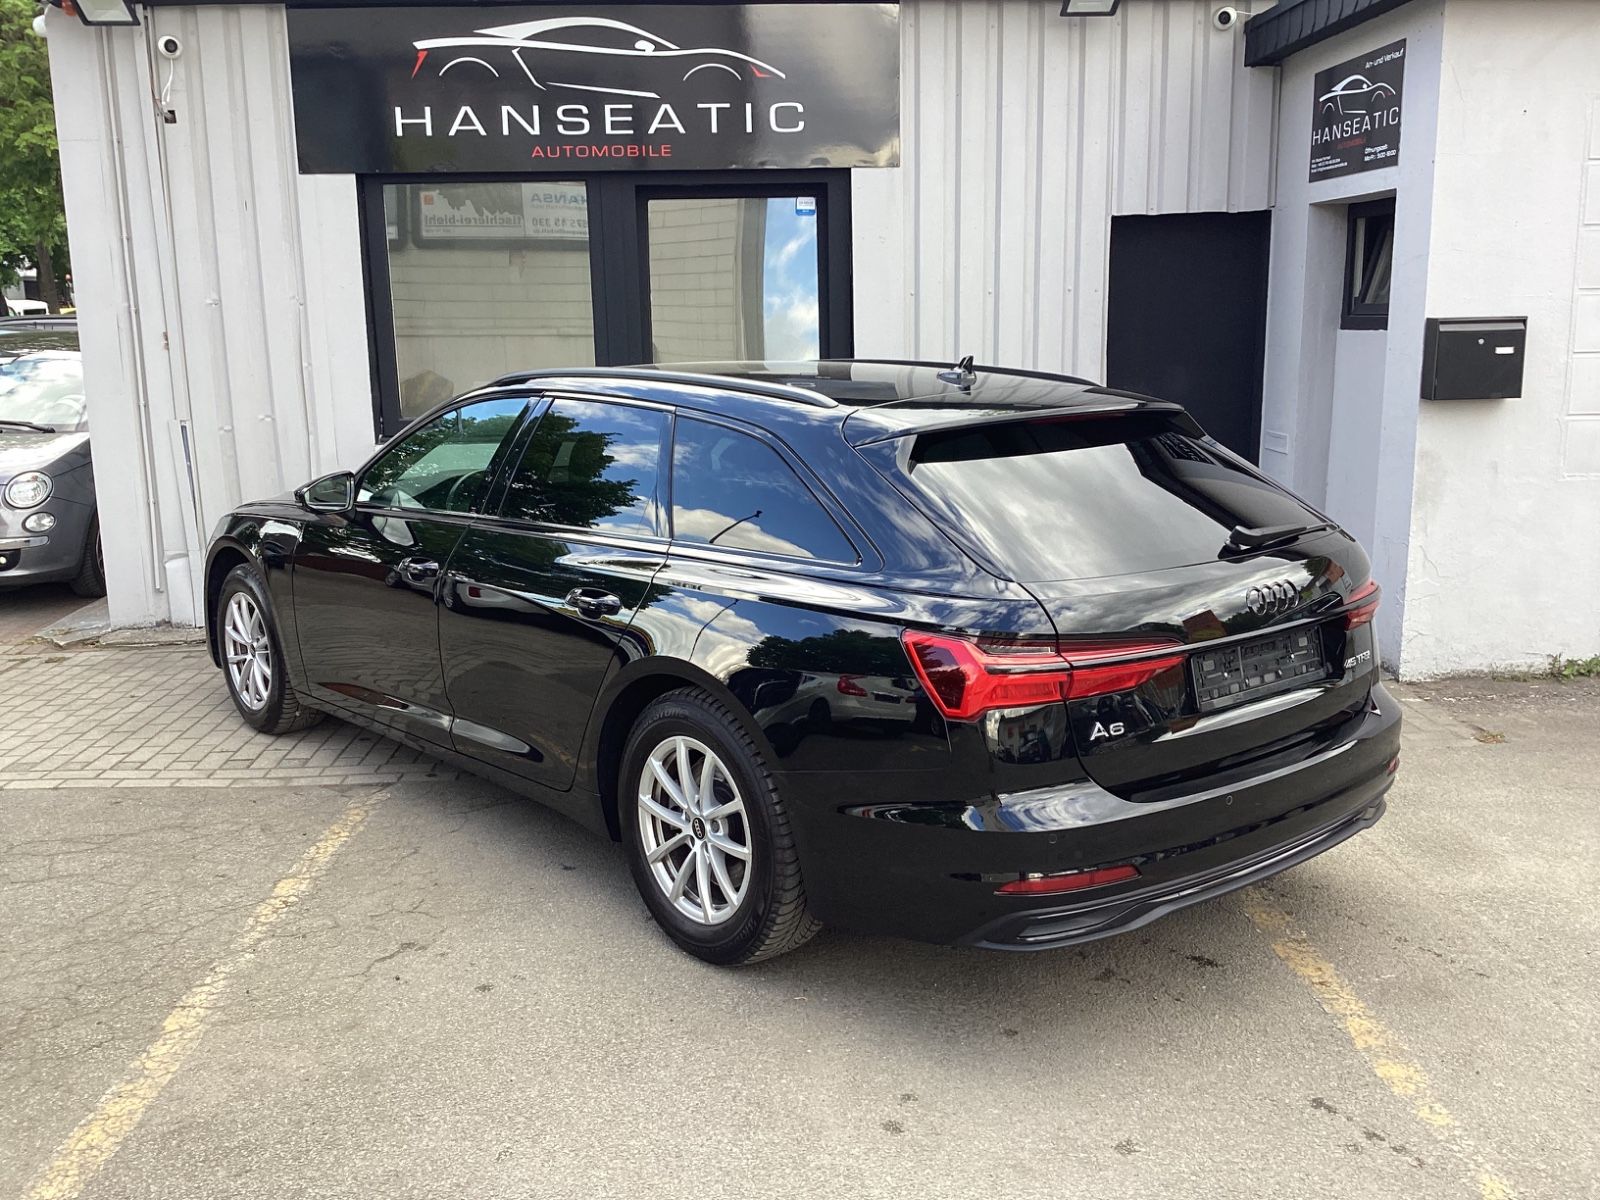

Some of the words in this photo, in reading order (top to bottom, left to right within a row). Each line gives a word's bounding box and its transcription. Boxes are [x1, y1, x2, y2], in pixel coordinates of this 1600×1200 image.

[1384, 48, 1404, 62] Verkauf
[394, 101, 806, 137] HANSEATIC
[1312, 106, 1399, 146] HANSEATIC
[531, 143, 673, 158] AUTOMOBILE
[1089, 721, 1125, 741] A6
